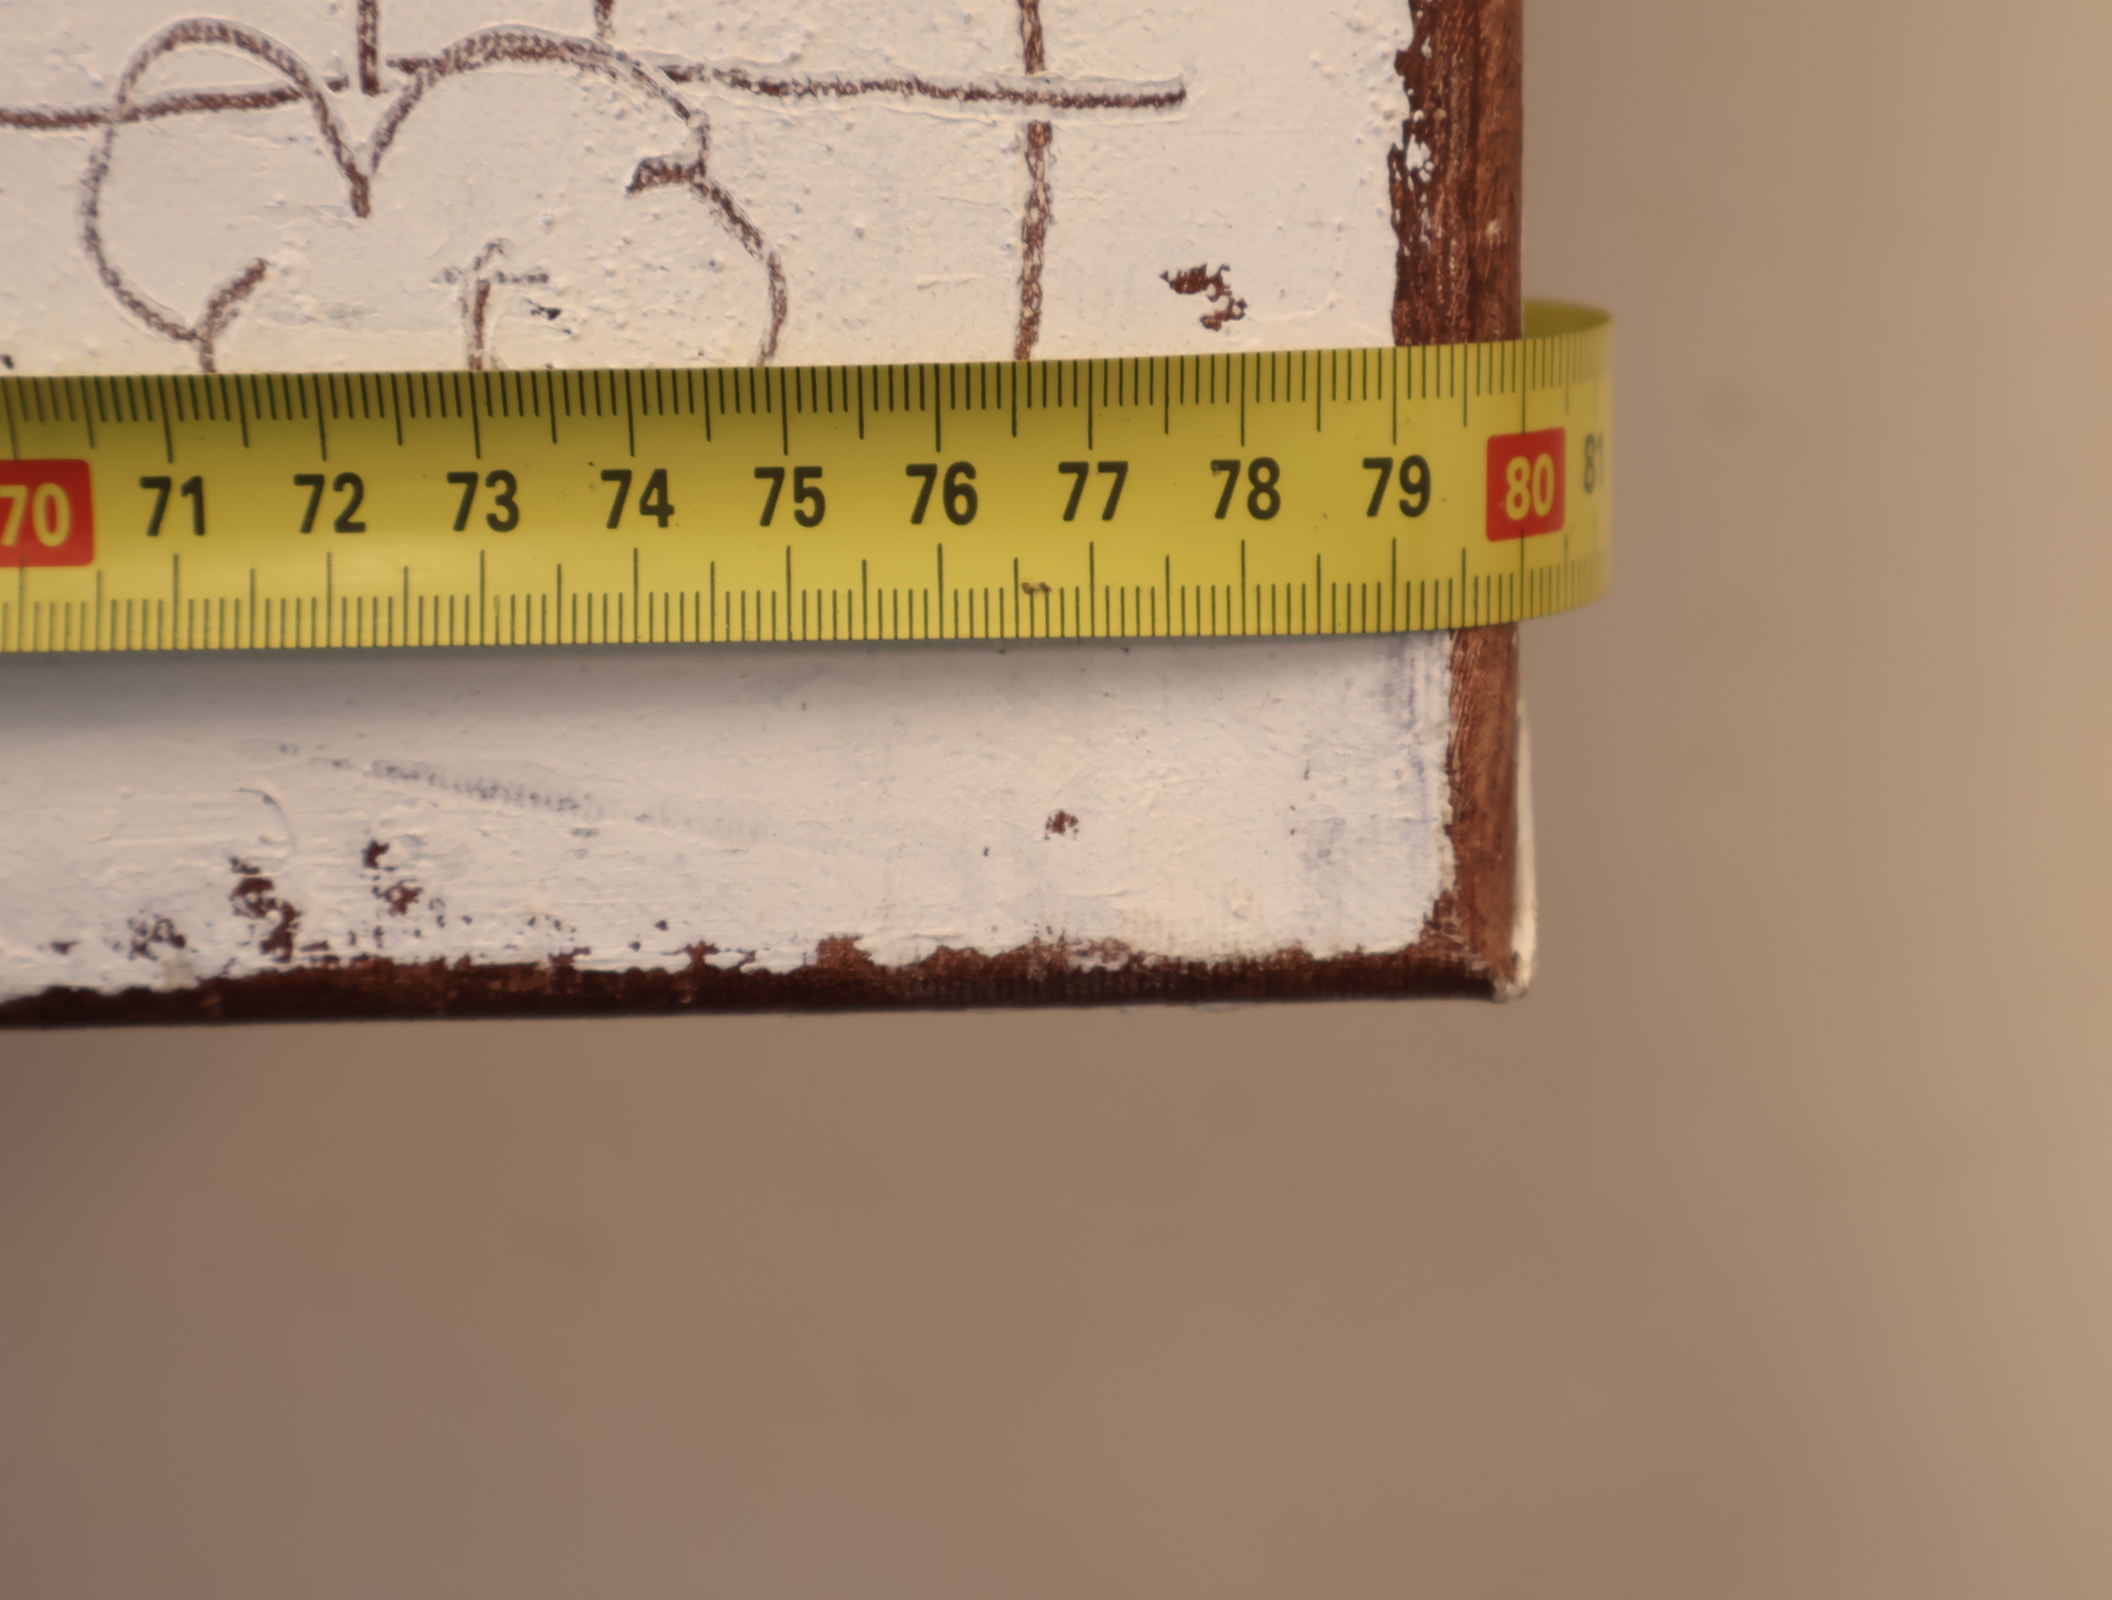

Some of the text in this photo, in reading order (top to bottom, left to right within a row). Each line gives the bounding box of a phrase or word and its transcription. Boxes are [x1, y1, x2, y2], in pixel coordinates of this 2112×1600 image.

[0, 432, 1604, 548] 70 71 72 73 74 75 76 77 78 79 80 81
